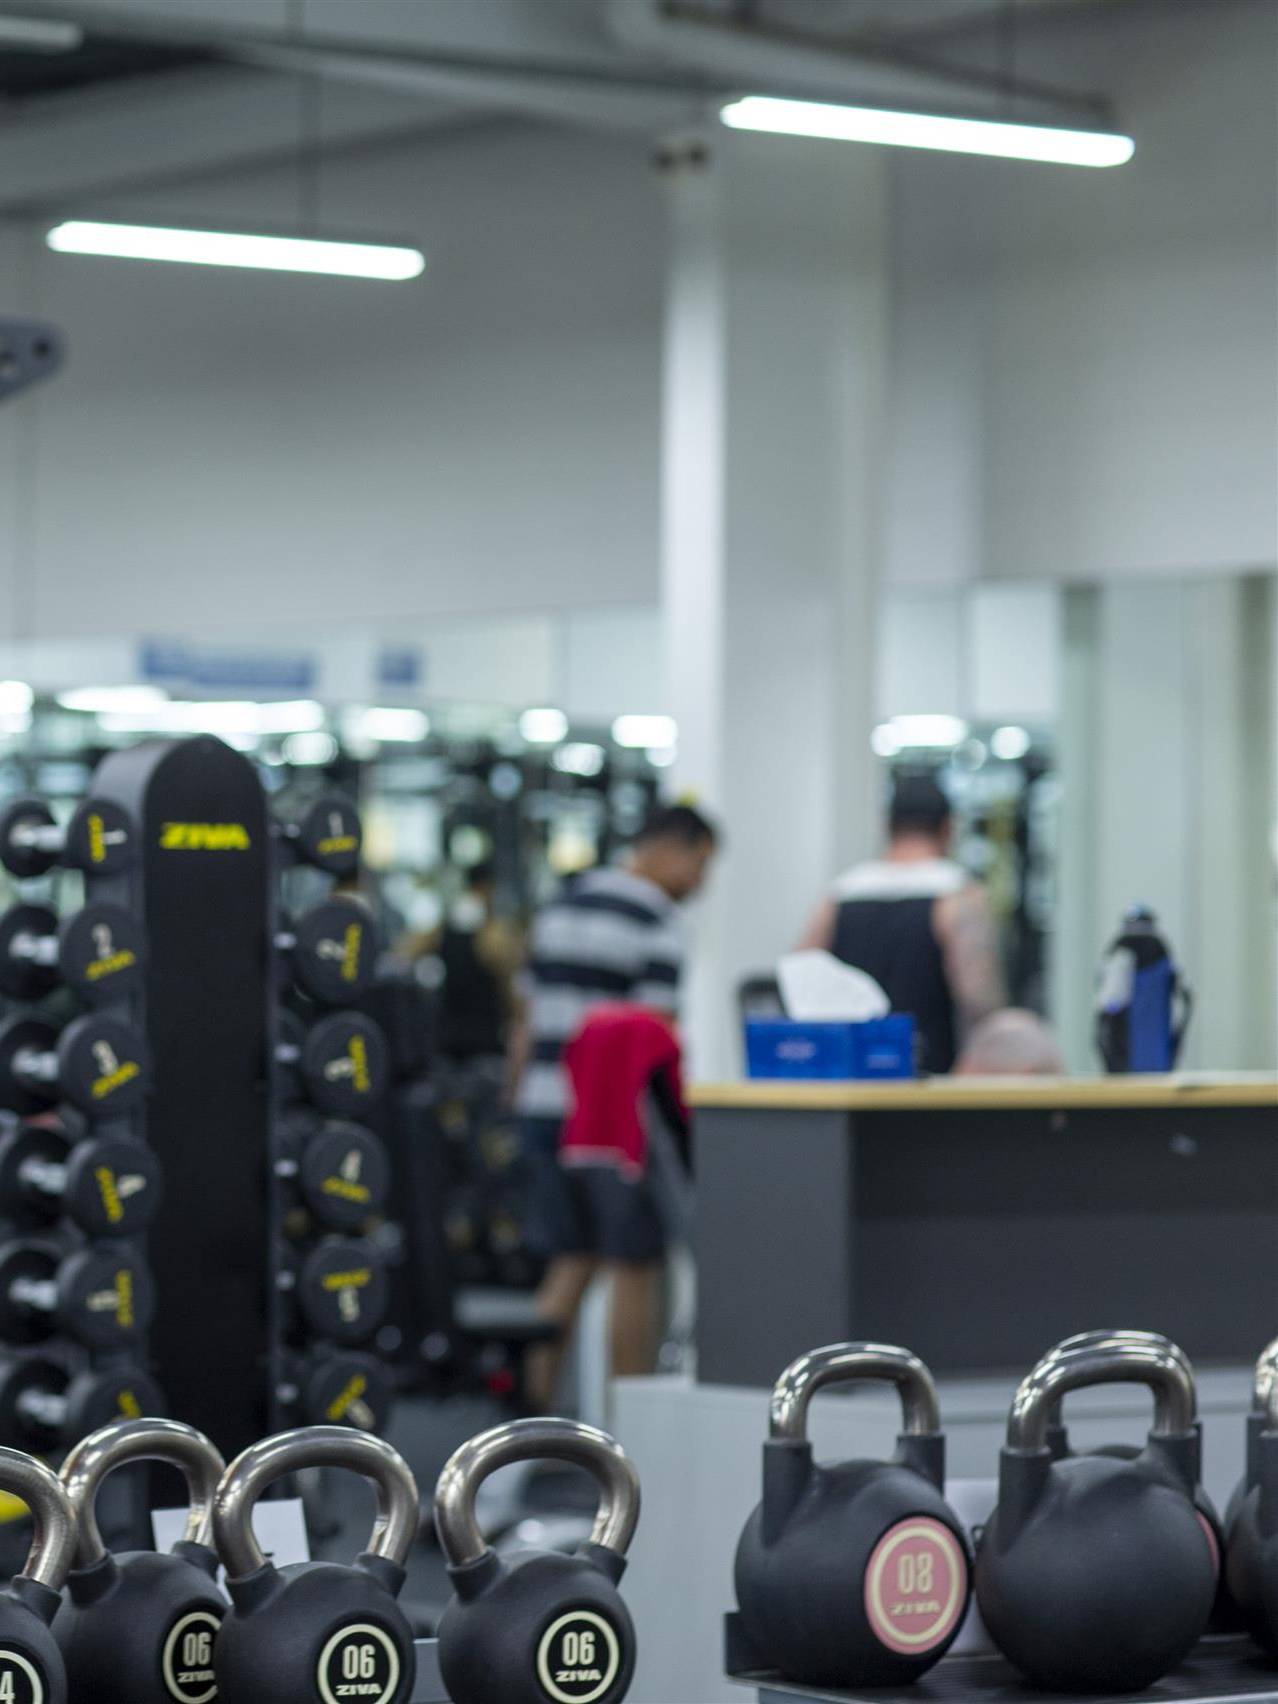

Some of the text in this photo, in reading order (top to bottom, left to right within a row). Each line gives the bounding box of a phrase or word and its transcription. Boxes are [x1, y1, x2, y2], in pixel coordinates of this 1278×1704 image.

[898, 1552, 934, 1595] 08
[183, 1631, 211, 1667] 06
[343, 1644, 376, 1680] 06
[562, 1631, 595, 1666] 06
[335, 1683, 382, 1696] ZIVA
[555, 1669, 602, 1682] ZIVA
